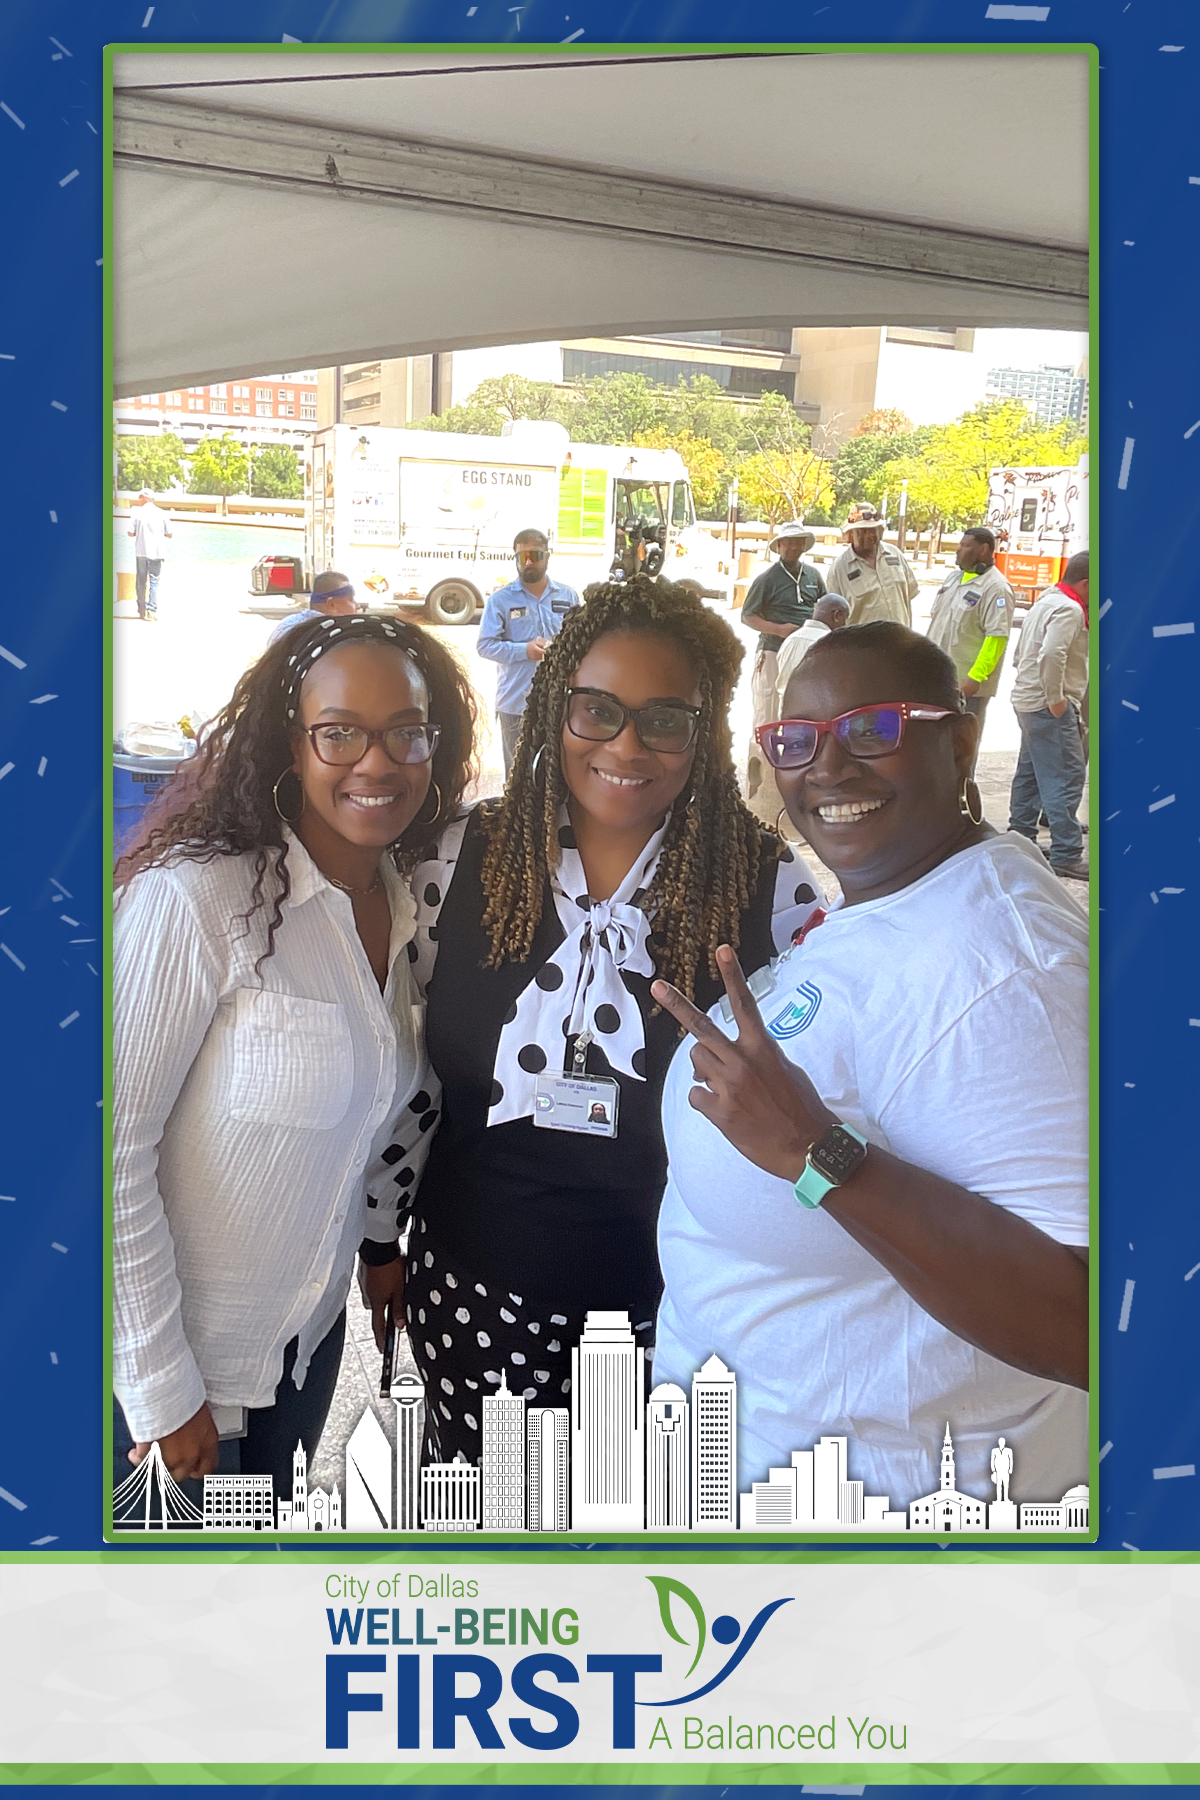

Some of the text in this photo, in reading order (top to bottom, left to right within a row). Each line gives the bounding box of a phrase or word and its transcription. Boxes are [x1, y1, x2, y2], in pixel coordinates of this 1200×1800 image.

[462, 470, 532, 487] EGG STAND
[405, 548, 515, 561] Gourmet Egg Sandw
[131, 772, 169, 783] BRUT
[576, 1084, 597, 1092] DALLAS
